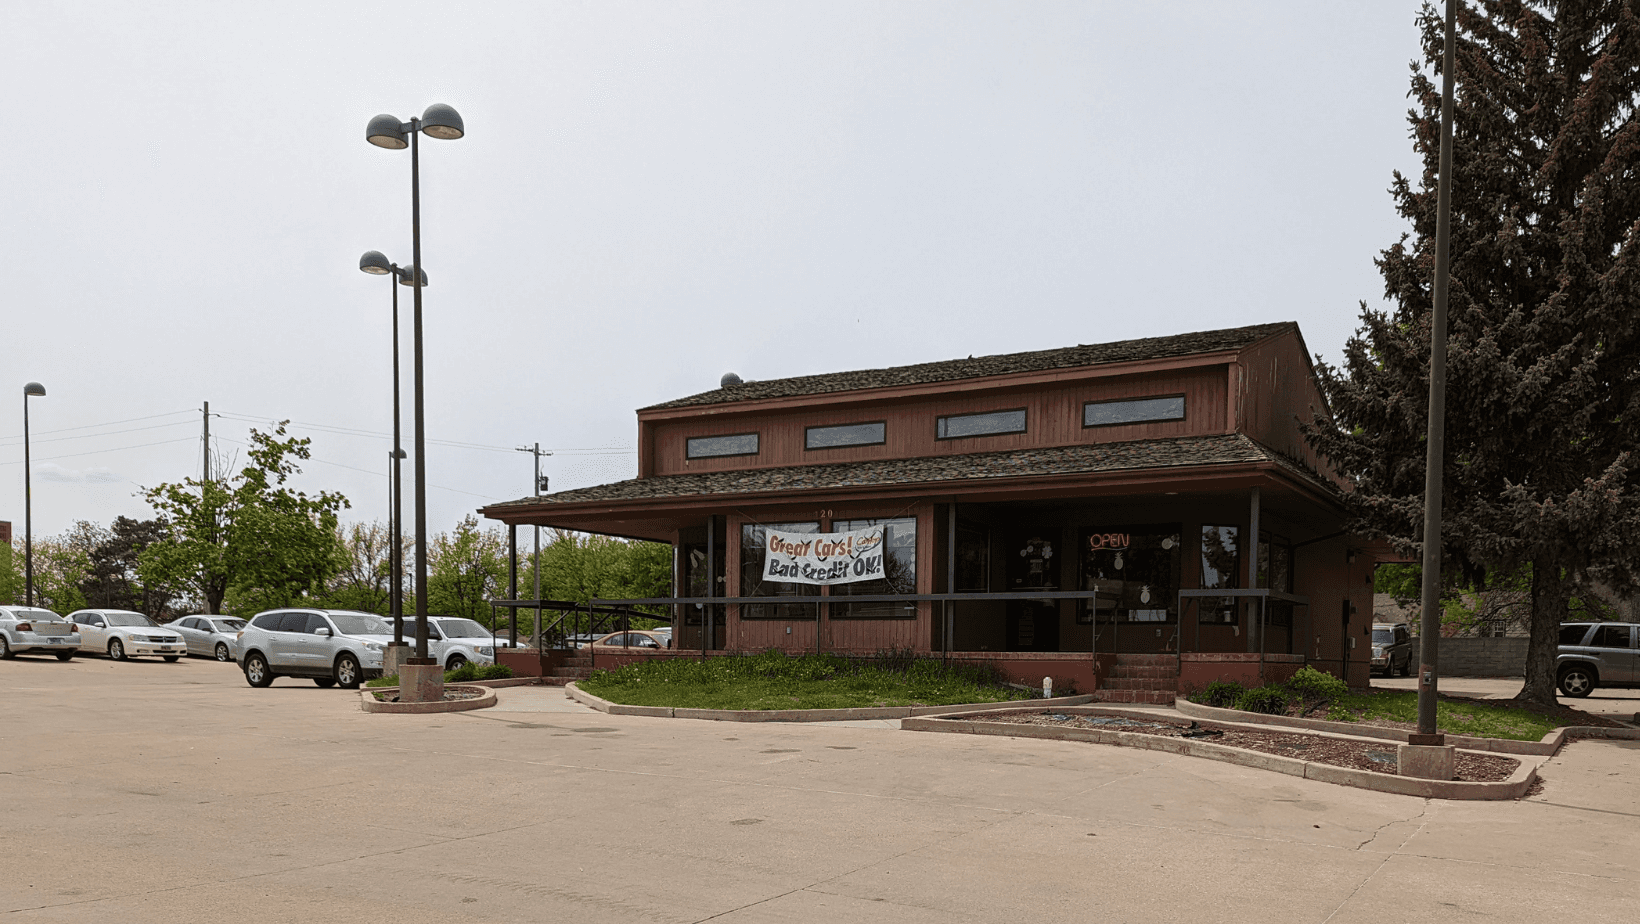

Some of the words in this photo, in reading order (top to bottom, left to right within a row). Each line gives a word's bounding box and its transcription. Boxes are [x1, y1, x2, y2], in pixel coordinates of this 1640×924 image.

[769, 535, 811, 557] Great
[814, 535, 853, 557] Cars!
[1090, 533, 1130, 548] OPEN
[768, 558, 799, 578] Bad
[801, 561, 850, 580] Credit
[853, 554, 882, 577] OK!
